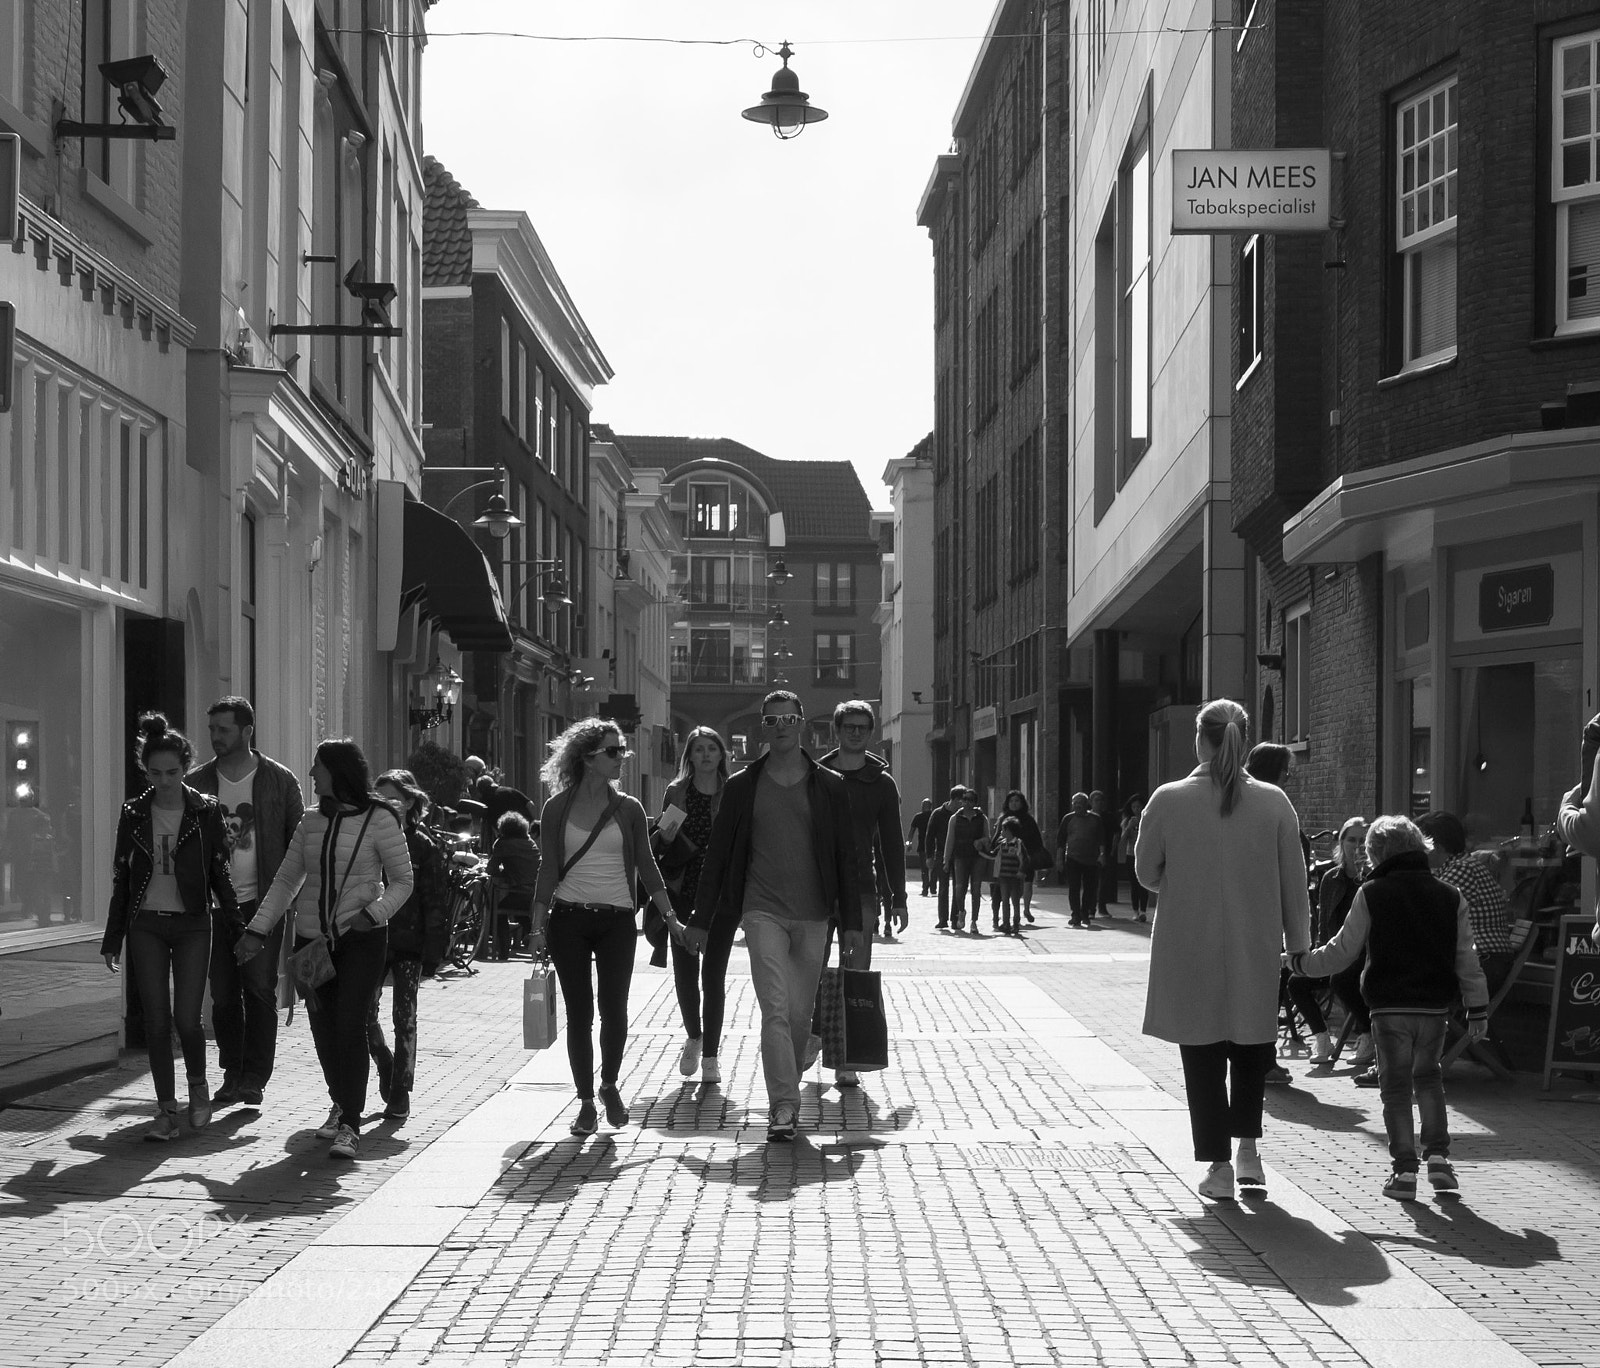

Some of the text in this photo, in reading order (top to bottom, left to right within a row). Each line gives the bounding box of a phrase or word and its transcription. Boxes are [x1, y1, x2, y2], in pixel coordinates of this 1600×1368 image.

[1187, 166, 1316, 188] JAN MEES
[1187, 198, 1316, 218] Tabakspecialist
[1498, 584, 1532, 613] Sigaren
